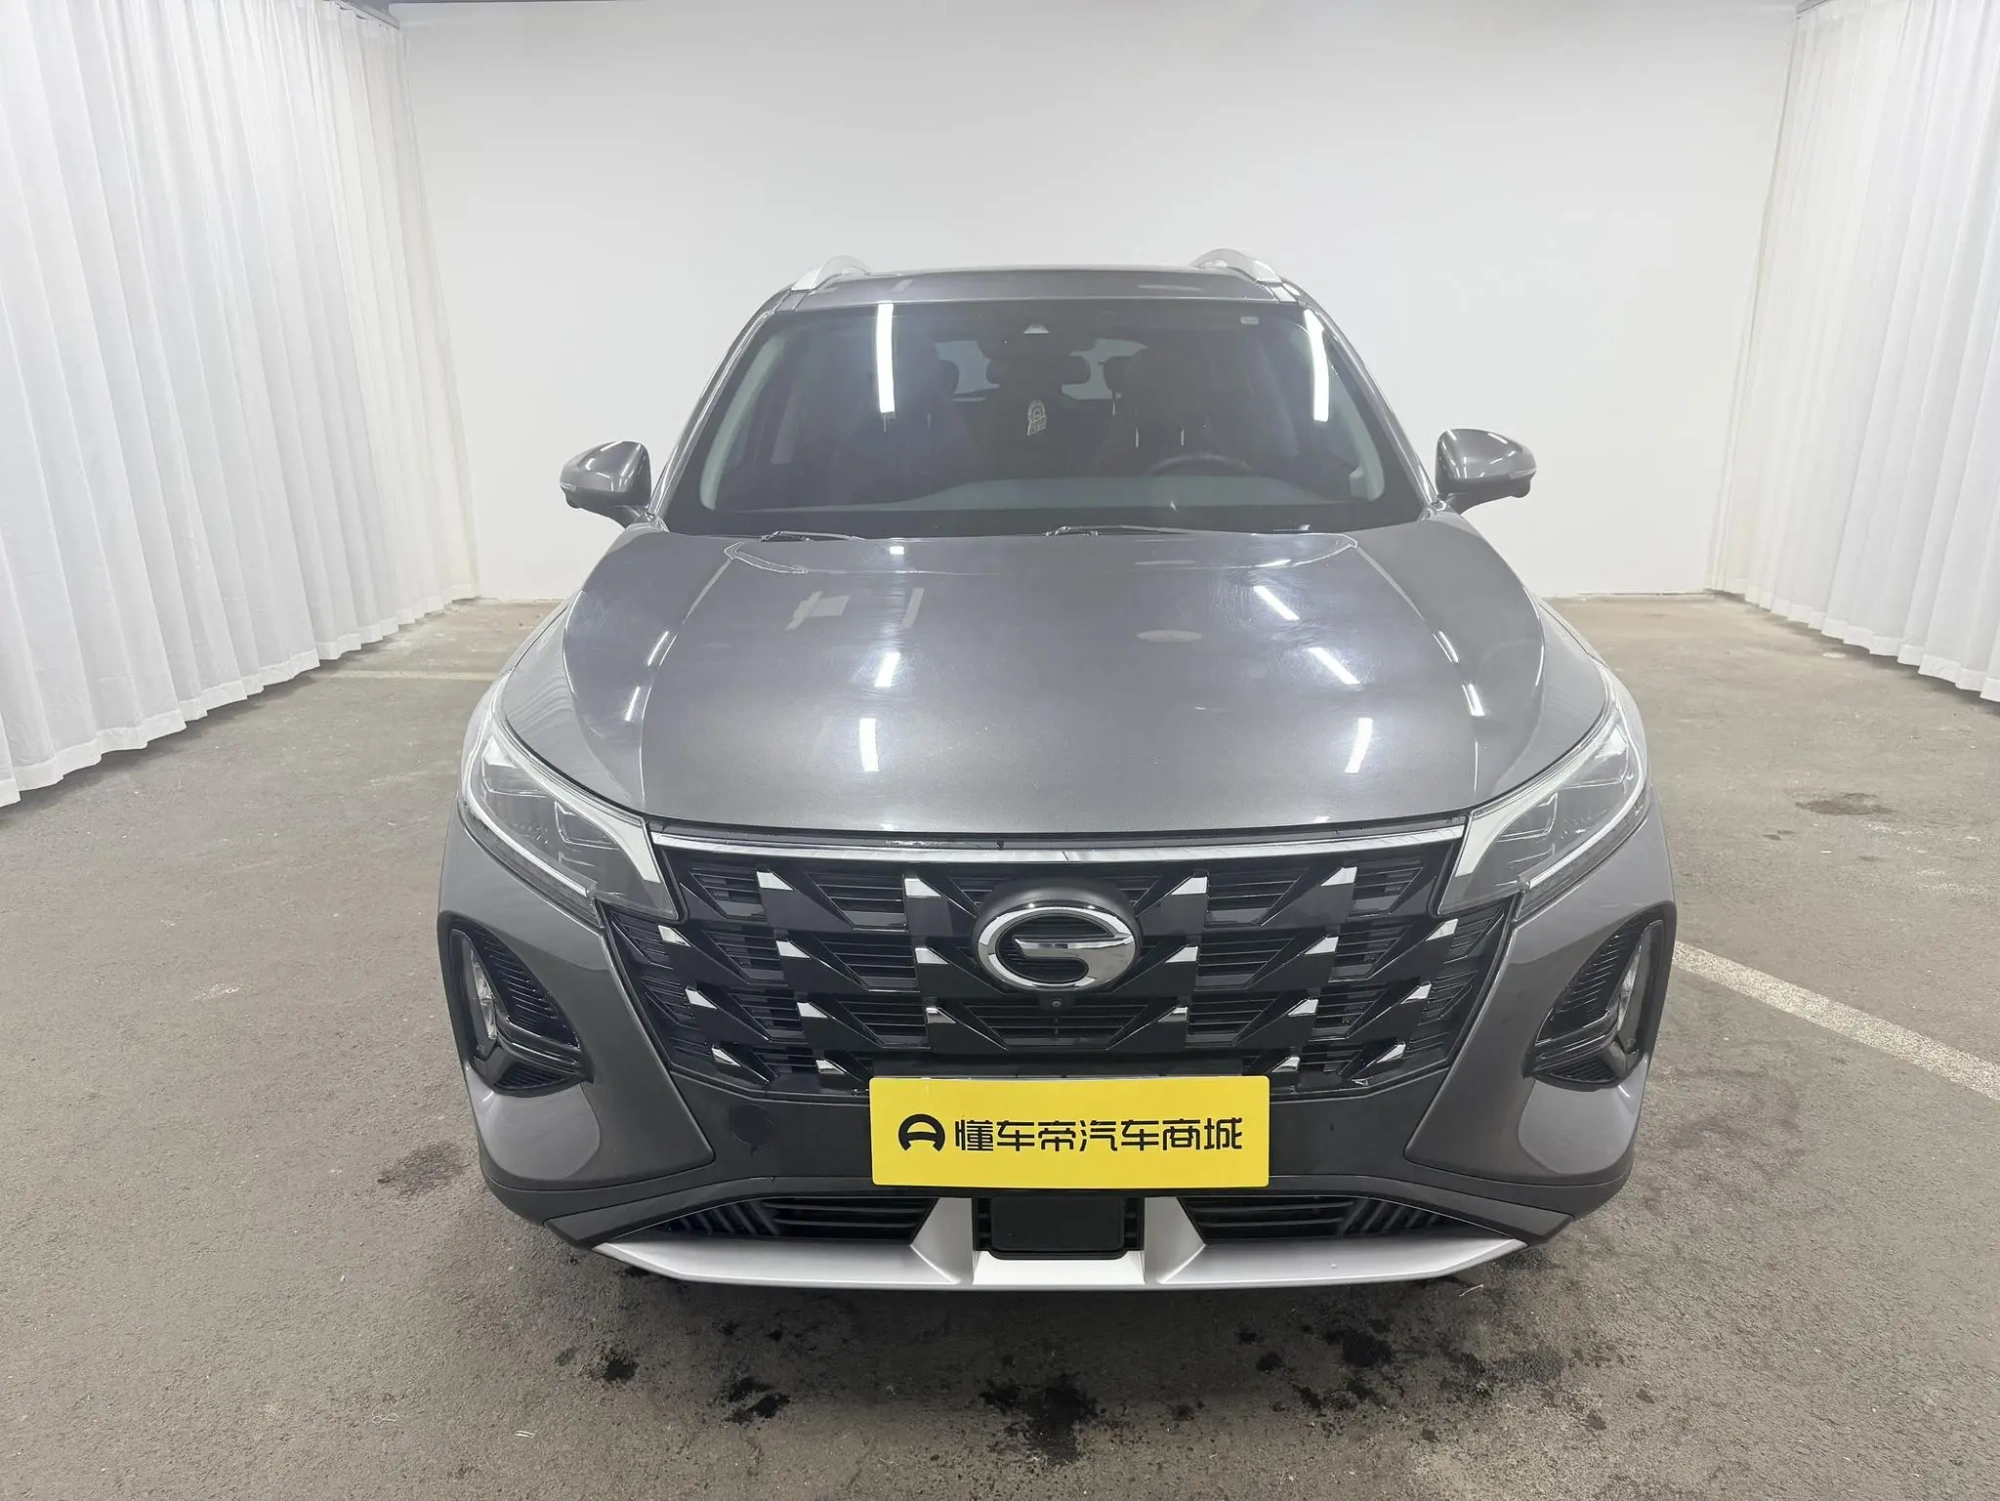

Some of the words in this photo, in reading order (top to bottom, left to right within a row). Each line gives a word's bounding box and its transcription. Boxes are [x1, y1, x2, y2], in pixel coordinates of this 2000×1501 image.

[955, 1117, 1243, 1152] 懂车帝汽车商城
